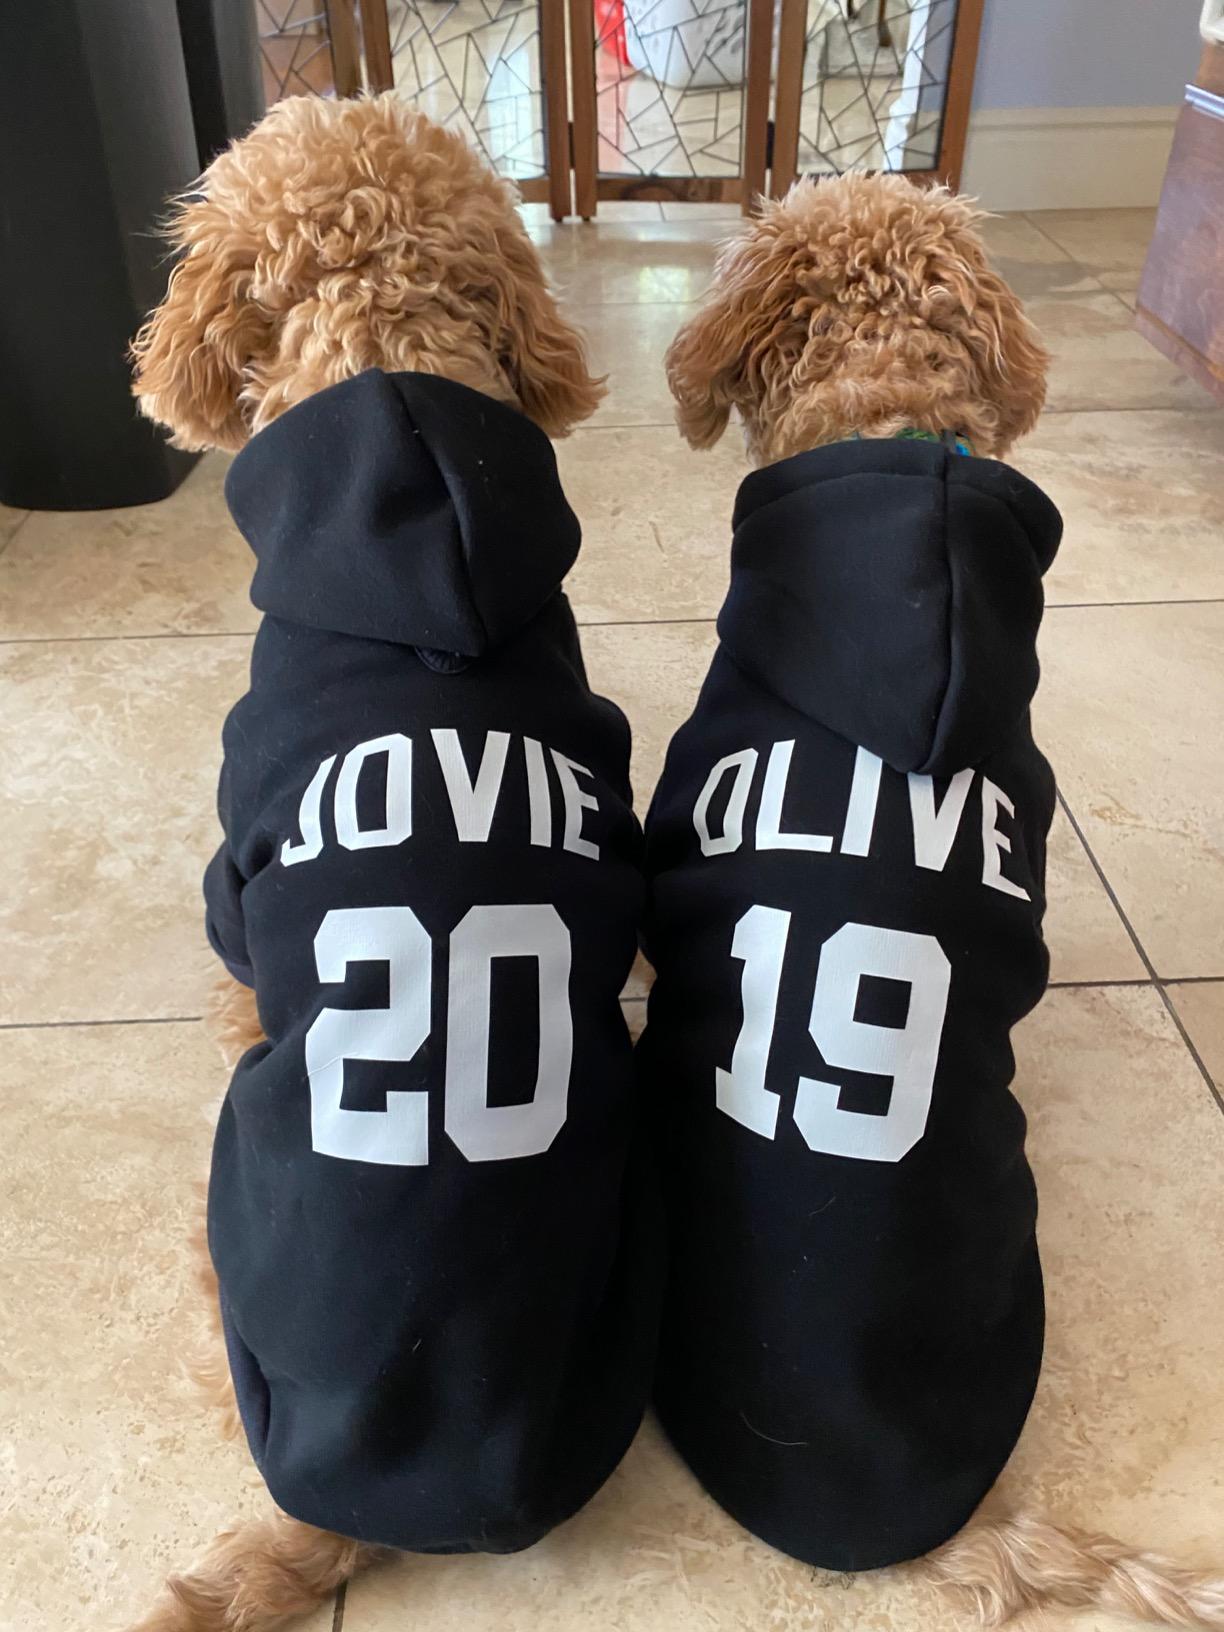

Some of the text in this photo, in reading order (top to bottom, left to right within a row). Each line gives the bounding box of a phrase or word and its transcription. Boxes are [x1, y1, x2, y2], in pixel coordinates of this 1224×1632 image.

[280, 728, 600, 867] JOVIE
[692, 739, 1032, 902] OLIVE
[305, 903, 574, 1166] 20
[715, 904, 952, 1162] 19
